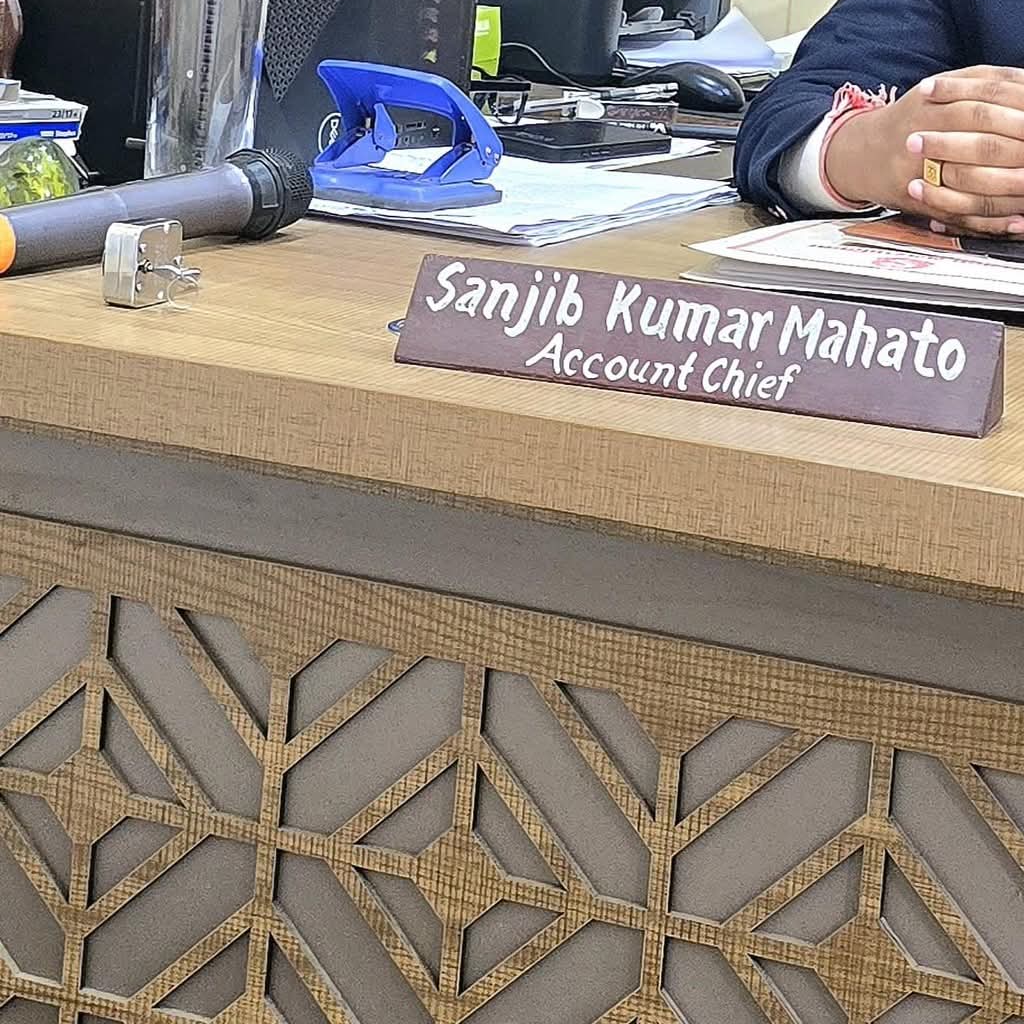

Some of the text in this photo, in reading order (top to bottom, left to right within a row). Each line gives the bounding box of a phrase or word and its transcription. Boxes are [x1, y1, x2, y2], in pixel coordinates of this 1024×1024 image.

[425, 261, 967, 382] Sanjib Kumar Mahato
[525, 332, 801, 401] Account Chief
